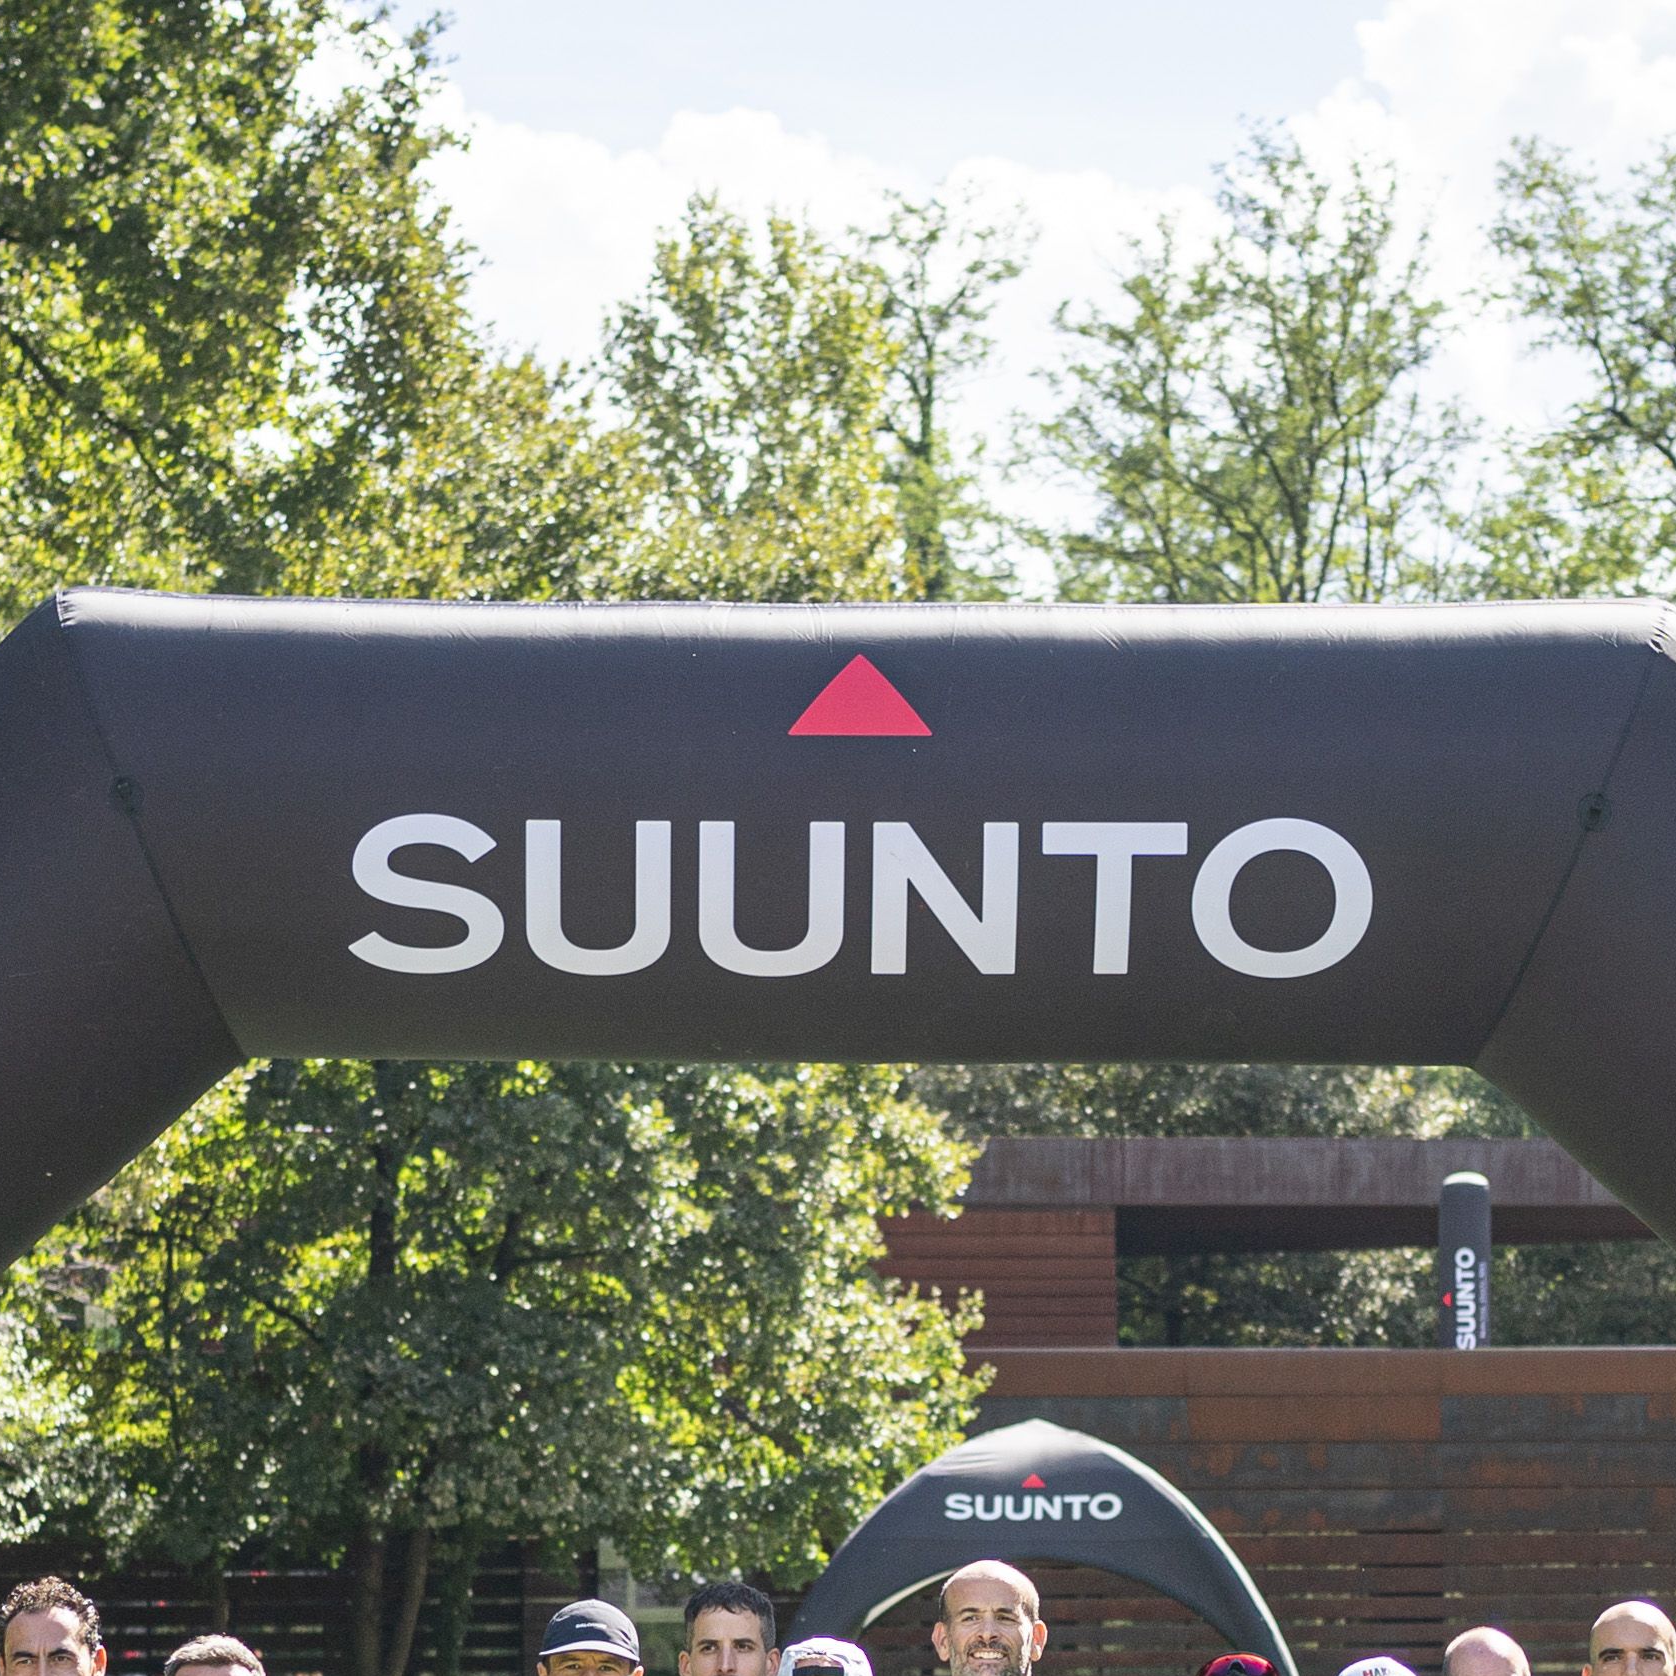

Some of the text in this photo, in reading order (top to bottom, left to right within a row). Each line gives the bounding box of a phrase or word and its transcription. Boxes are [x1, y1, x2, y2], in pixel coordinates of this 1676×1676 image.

[348, 814, 1373, 979] SUUNTO
[1455, 1248, 1477, 1350] SUUNTO
[944, 1493, 1122, 1521] SUUNTO
